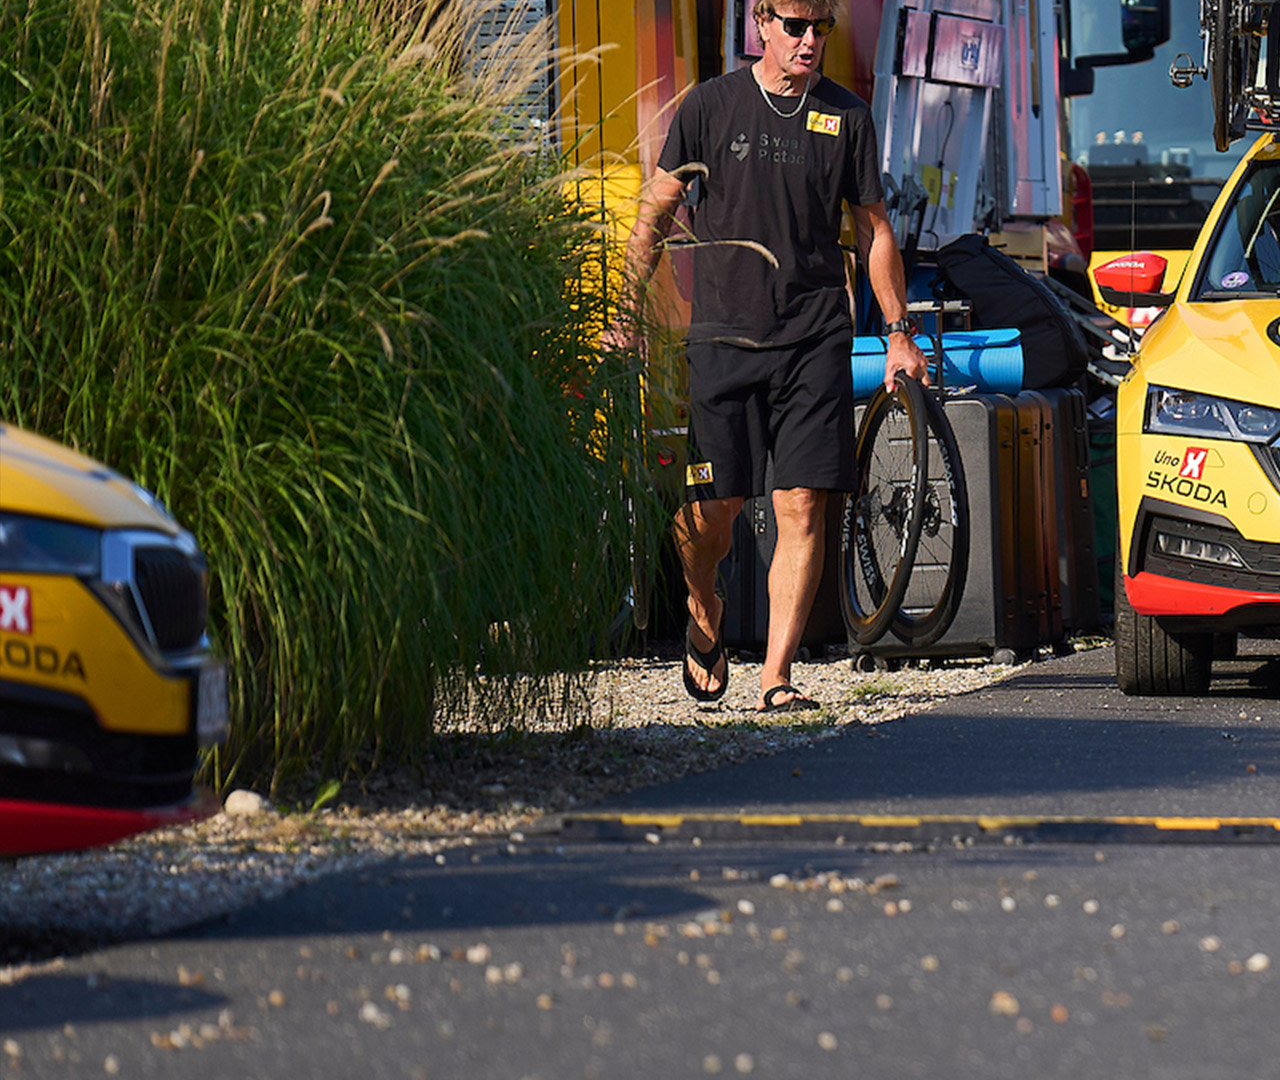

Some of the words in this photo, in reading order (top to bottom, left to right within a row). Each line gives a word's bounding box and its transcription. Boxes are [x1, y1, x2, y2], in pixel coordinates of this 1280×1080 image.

[1154, 450, 1180, 466] Uno
[1180, 450, 1207, 478] X
[0, 640, 87, 681] ODA
